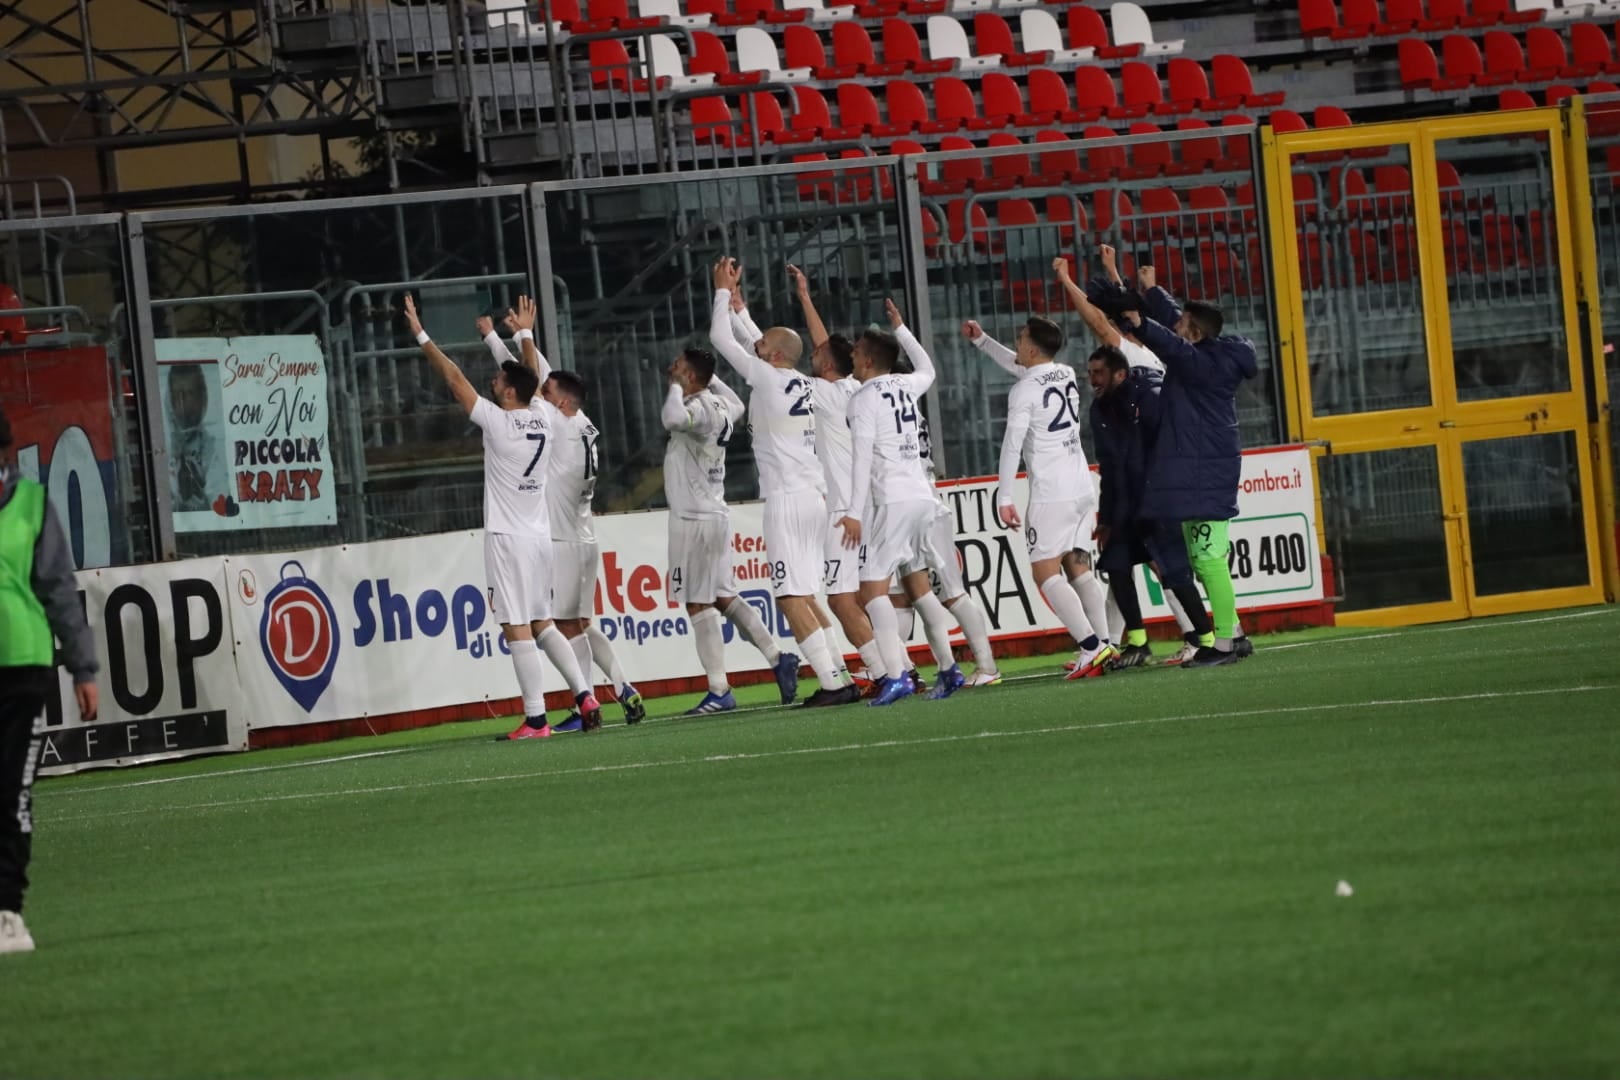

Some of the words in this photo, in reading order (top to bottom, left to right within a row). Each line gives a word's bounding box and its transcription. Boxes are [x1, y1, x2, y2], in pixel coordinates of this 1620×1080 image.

[223, 354, 265, 388] Sarai
[265, 352, 320, 386] Sempre
[229, 403, 263, 425] con
[265, 386, 317, 437] Noi
[881, 387, 917, 434] 14
[1042, 381, 1080, 432] 20
[234, 437, 322, 467] PICCOLA
[522, 433, 546, 477] 7
[236, 467, 323, 504] KRAZY
[731, 533, 767, 552] ter
[1190, 523, 1212, 543] 99
[1258, 532, 1307, 576] 400
[672, 566, 683, 586] 4
[353, 578, 486, 650] Shop
[600, 615, 689, 646] D'Aprea
[469, 631, 493, 659] di
